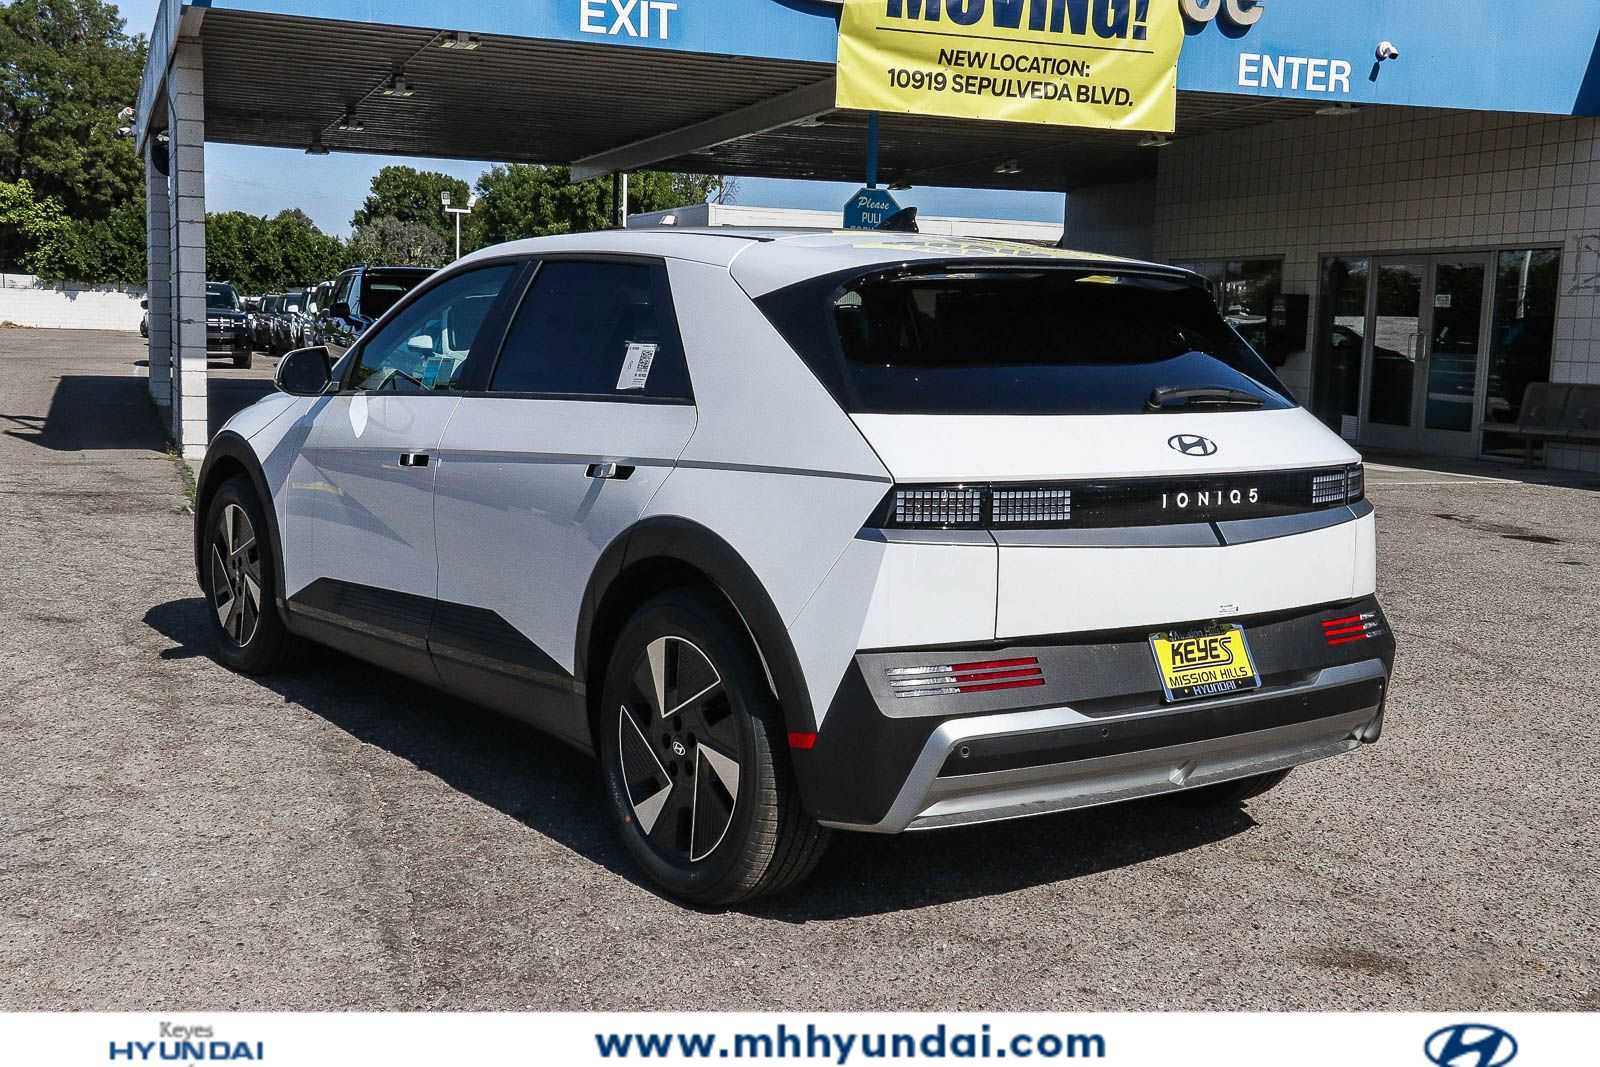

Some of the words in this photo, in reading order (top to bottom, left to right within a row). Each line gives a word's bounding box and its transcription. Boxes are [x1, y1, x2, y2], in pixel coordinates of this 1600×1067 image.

[579, 0, 677, 40] EXIT
[937, 48, 990, 69] NEW
[990, 53, 1090, 78] LOCATION:
[1238, 53, 1351, 93] ENTER
[887, 68, 948, 91] 10919
[951, 77, 1072, 103] SEPULVEDA
[1076, 86, 1134, 107] BLVD.
[857, 196, 890, 210] Please
[1170, 636, 1233, 669] KEYES
[1169, 670, 1218, 687] MISSION
[1219, 666, 1248, 680] HILLS
[1193, 680, 1237, 695] HYUNDAI
